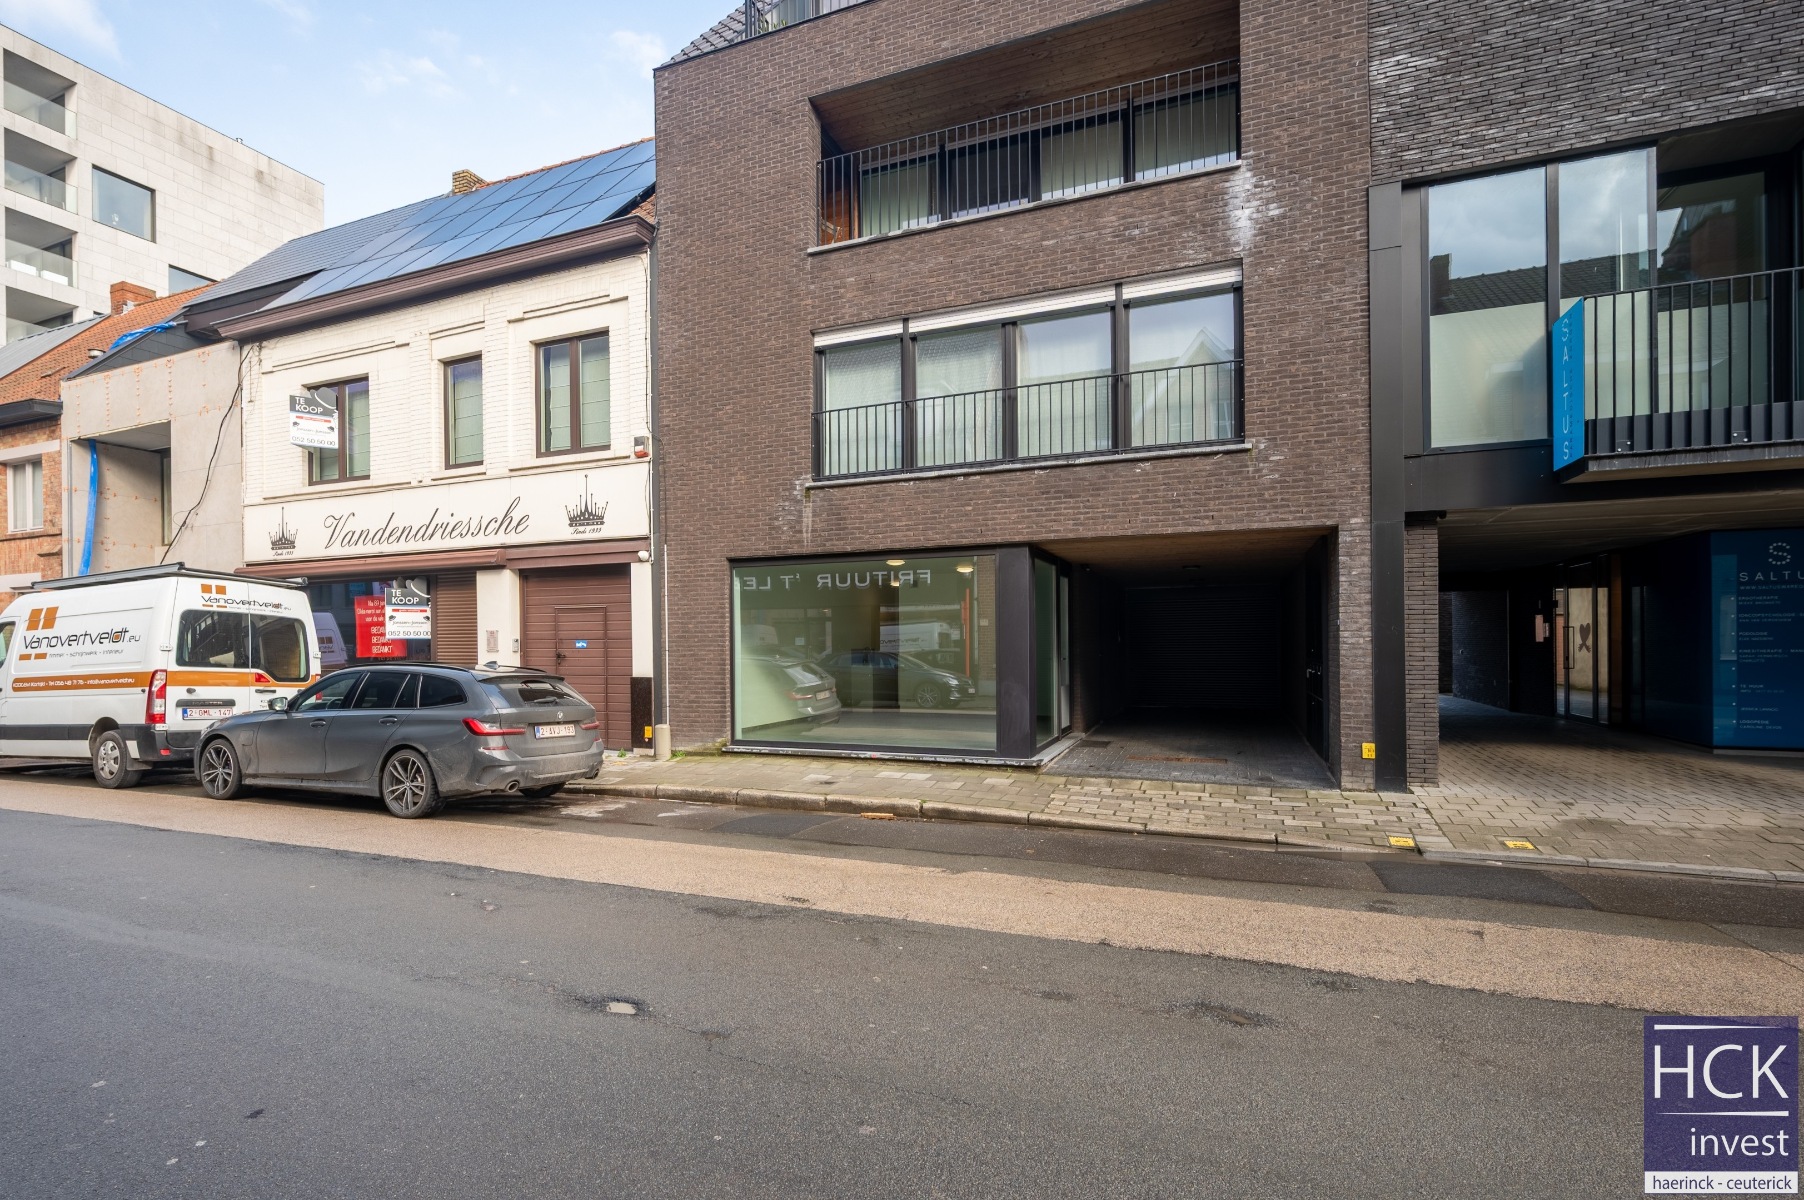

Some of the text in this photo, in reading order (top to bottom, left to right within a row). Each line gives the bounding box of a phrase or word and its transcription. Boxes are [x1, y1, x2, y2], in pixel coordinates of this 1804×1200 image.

[1561, 318, 1569, 461] SALTUS
[295, 397, 305, 405] TE
[295, 404, 323, 414] KOOP
[323, 496, 529, 550] Vandendriessche
[391, 589, 402, 597] TE
[392, 597, 419, 605] KOOP
[370, 626, 386, 634] BEDA
[23, 627, 141, 650] Vanovertveldt.eu
